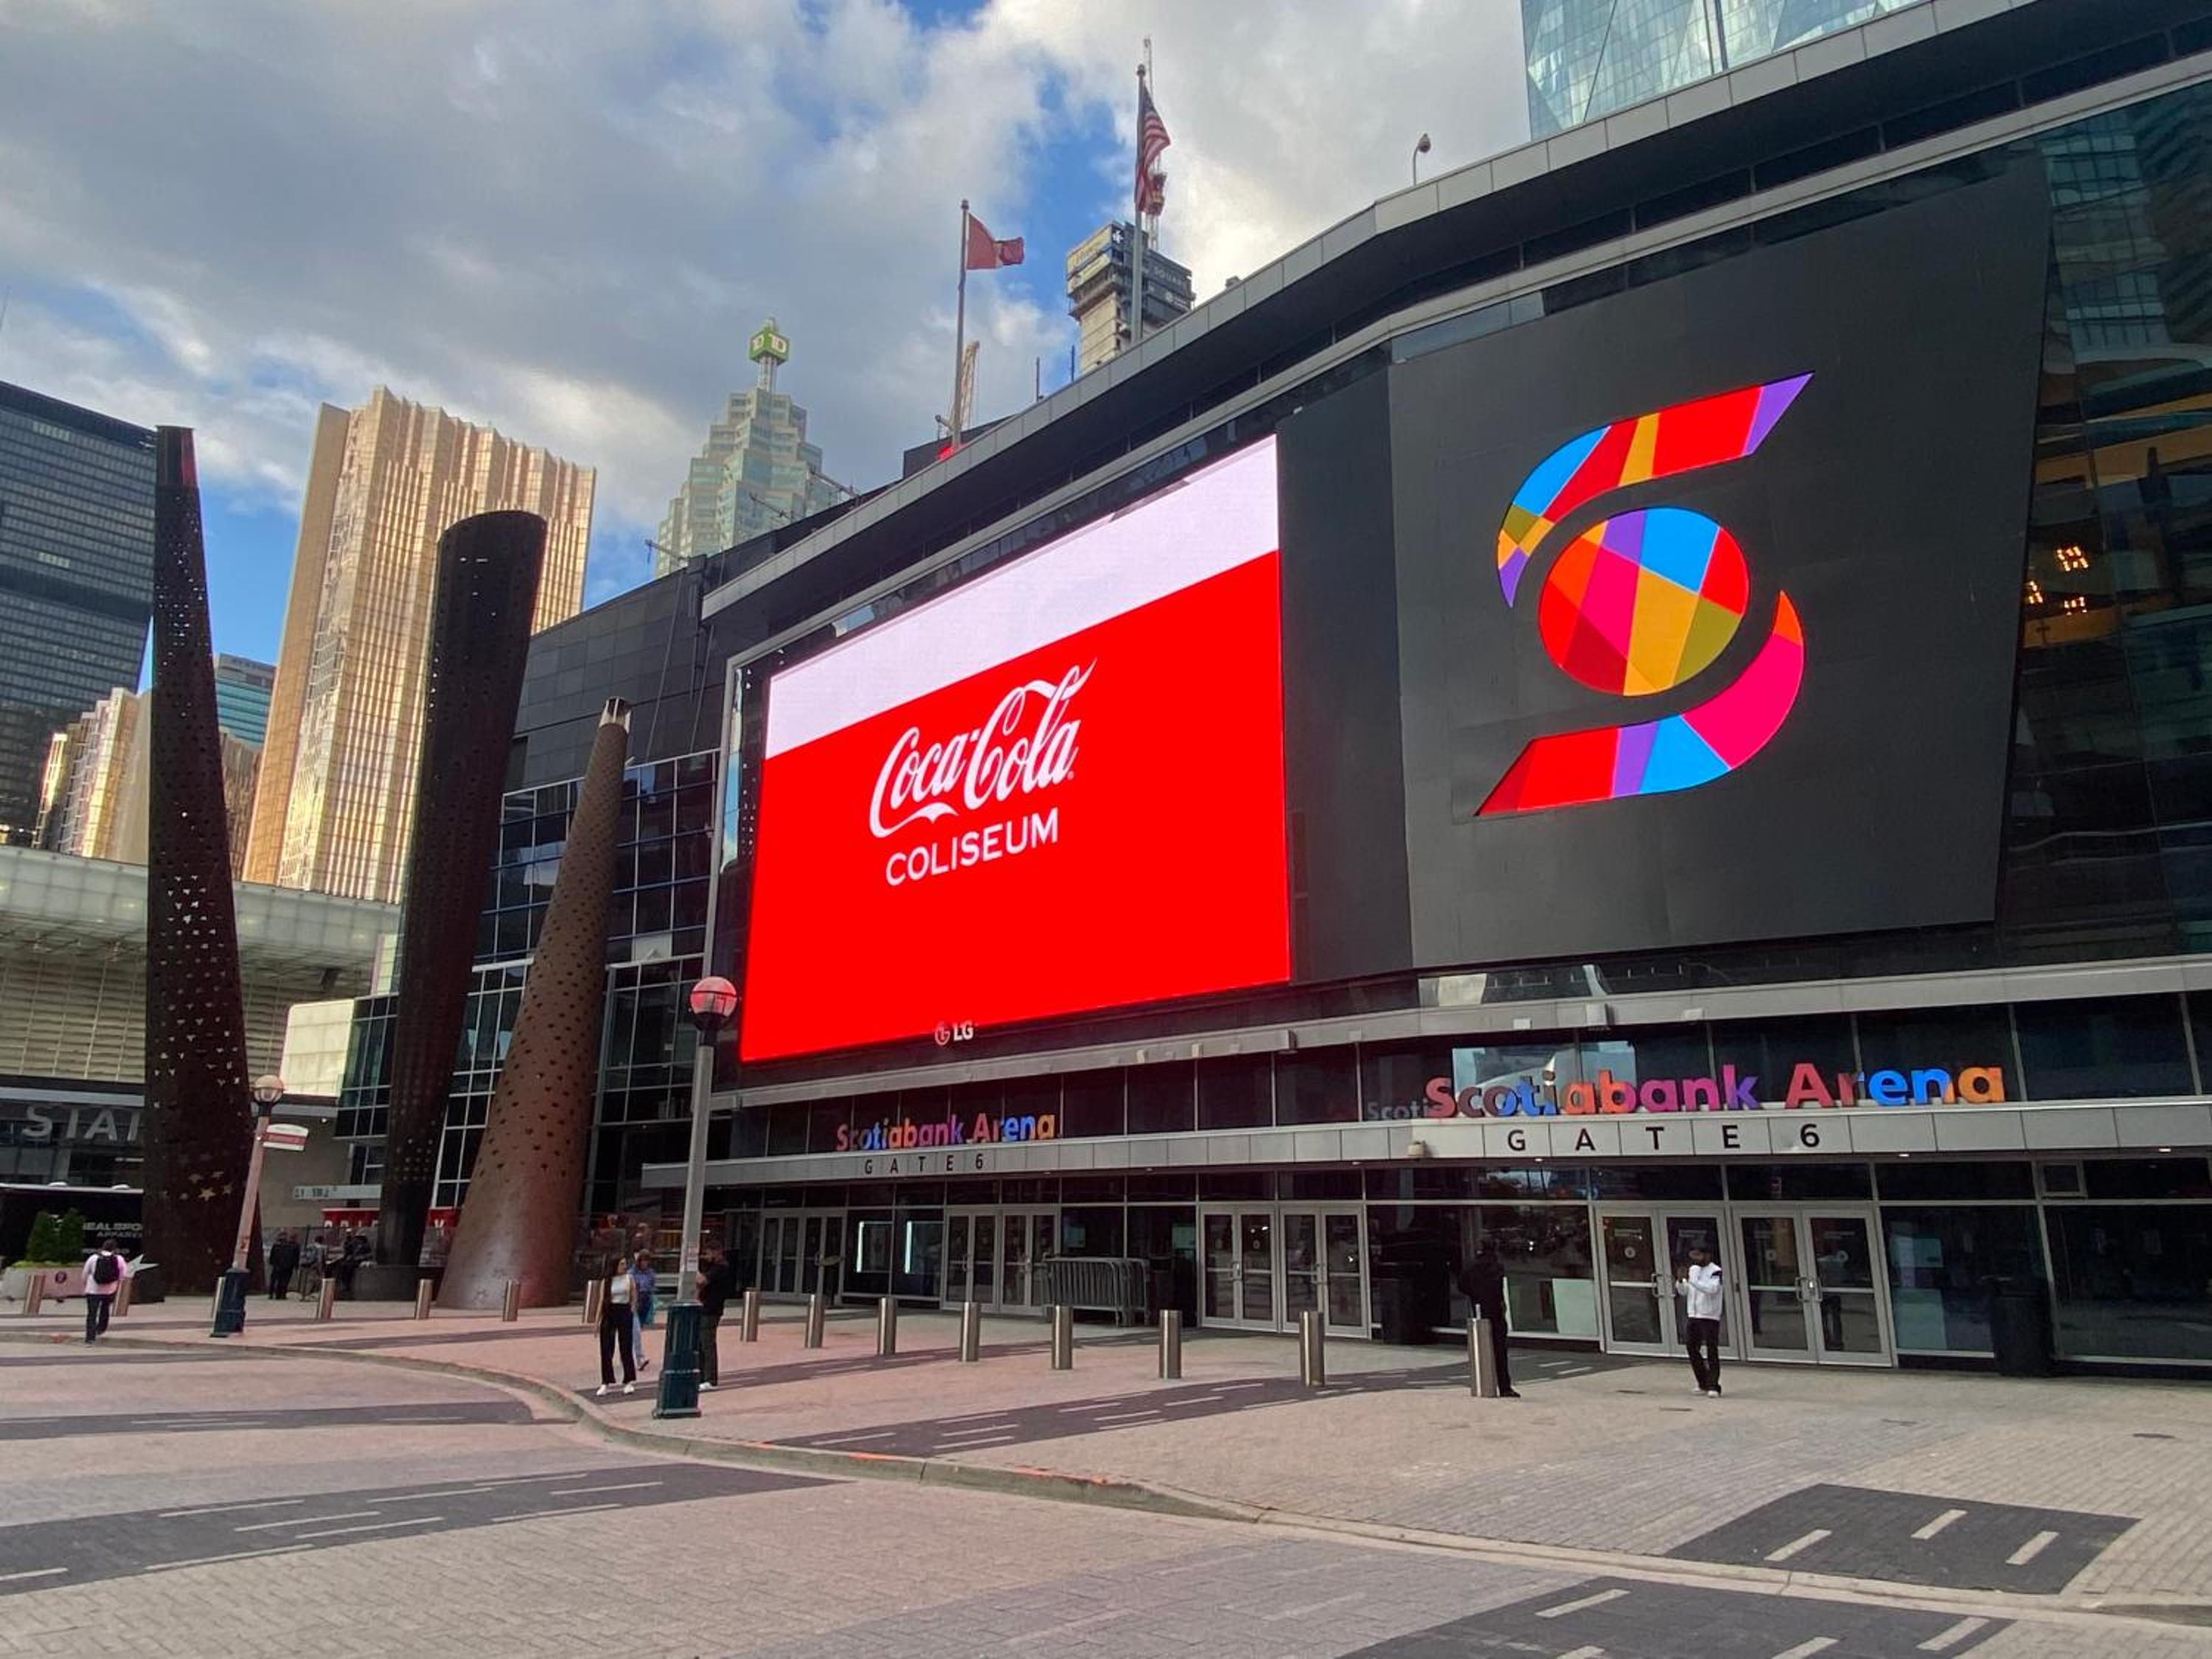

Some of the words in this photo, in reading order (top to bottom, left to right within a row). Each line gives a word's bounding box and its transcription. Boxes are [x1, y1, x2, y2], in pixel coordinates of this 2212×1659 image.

[870, 656, 1097, 838] Coca-Cola
[886, 807, 1059, 886] COLISEUM
[953, 1020, 974, 1042] LG
[1426, 1064, 1759, 1118] Scotiabank
[1784, 1062, 2006, 1110] Arena
[836, 1114, 964, 1152] Scotiabank
[973, 1113, 1055, 1143] Arena
[1508, 1125, 1741, 1152] GATE
[1800, 1122, 1820, 1148] 6
[864, 1154, 954, 1175] GATE
[975, 1152, 984, 1170] 6
